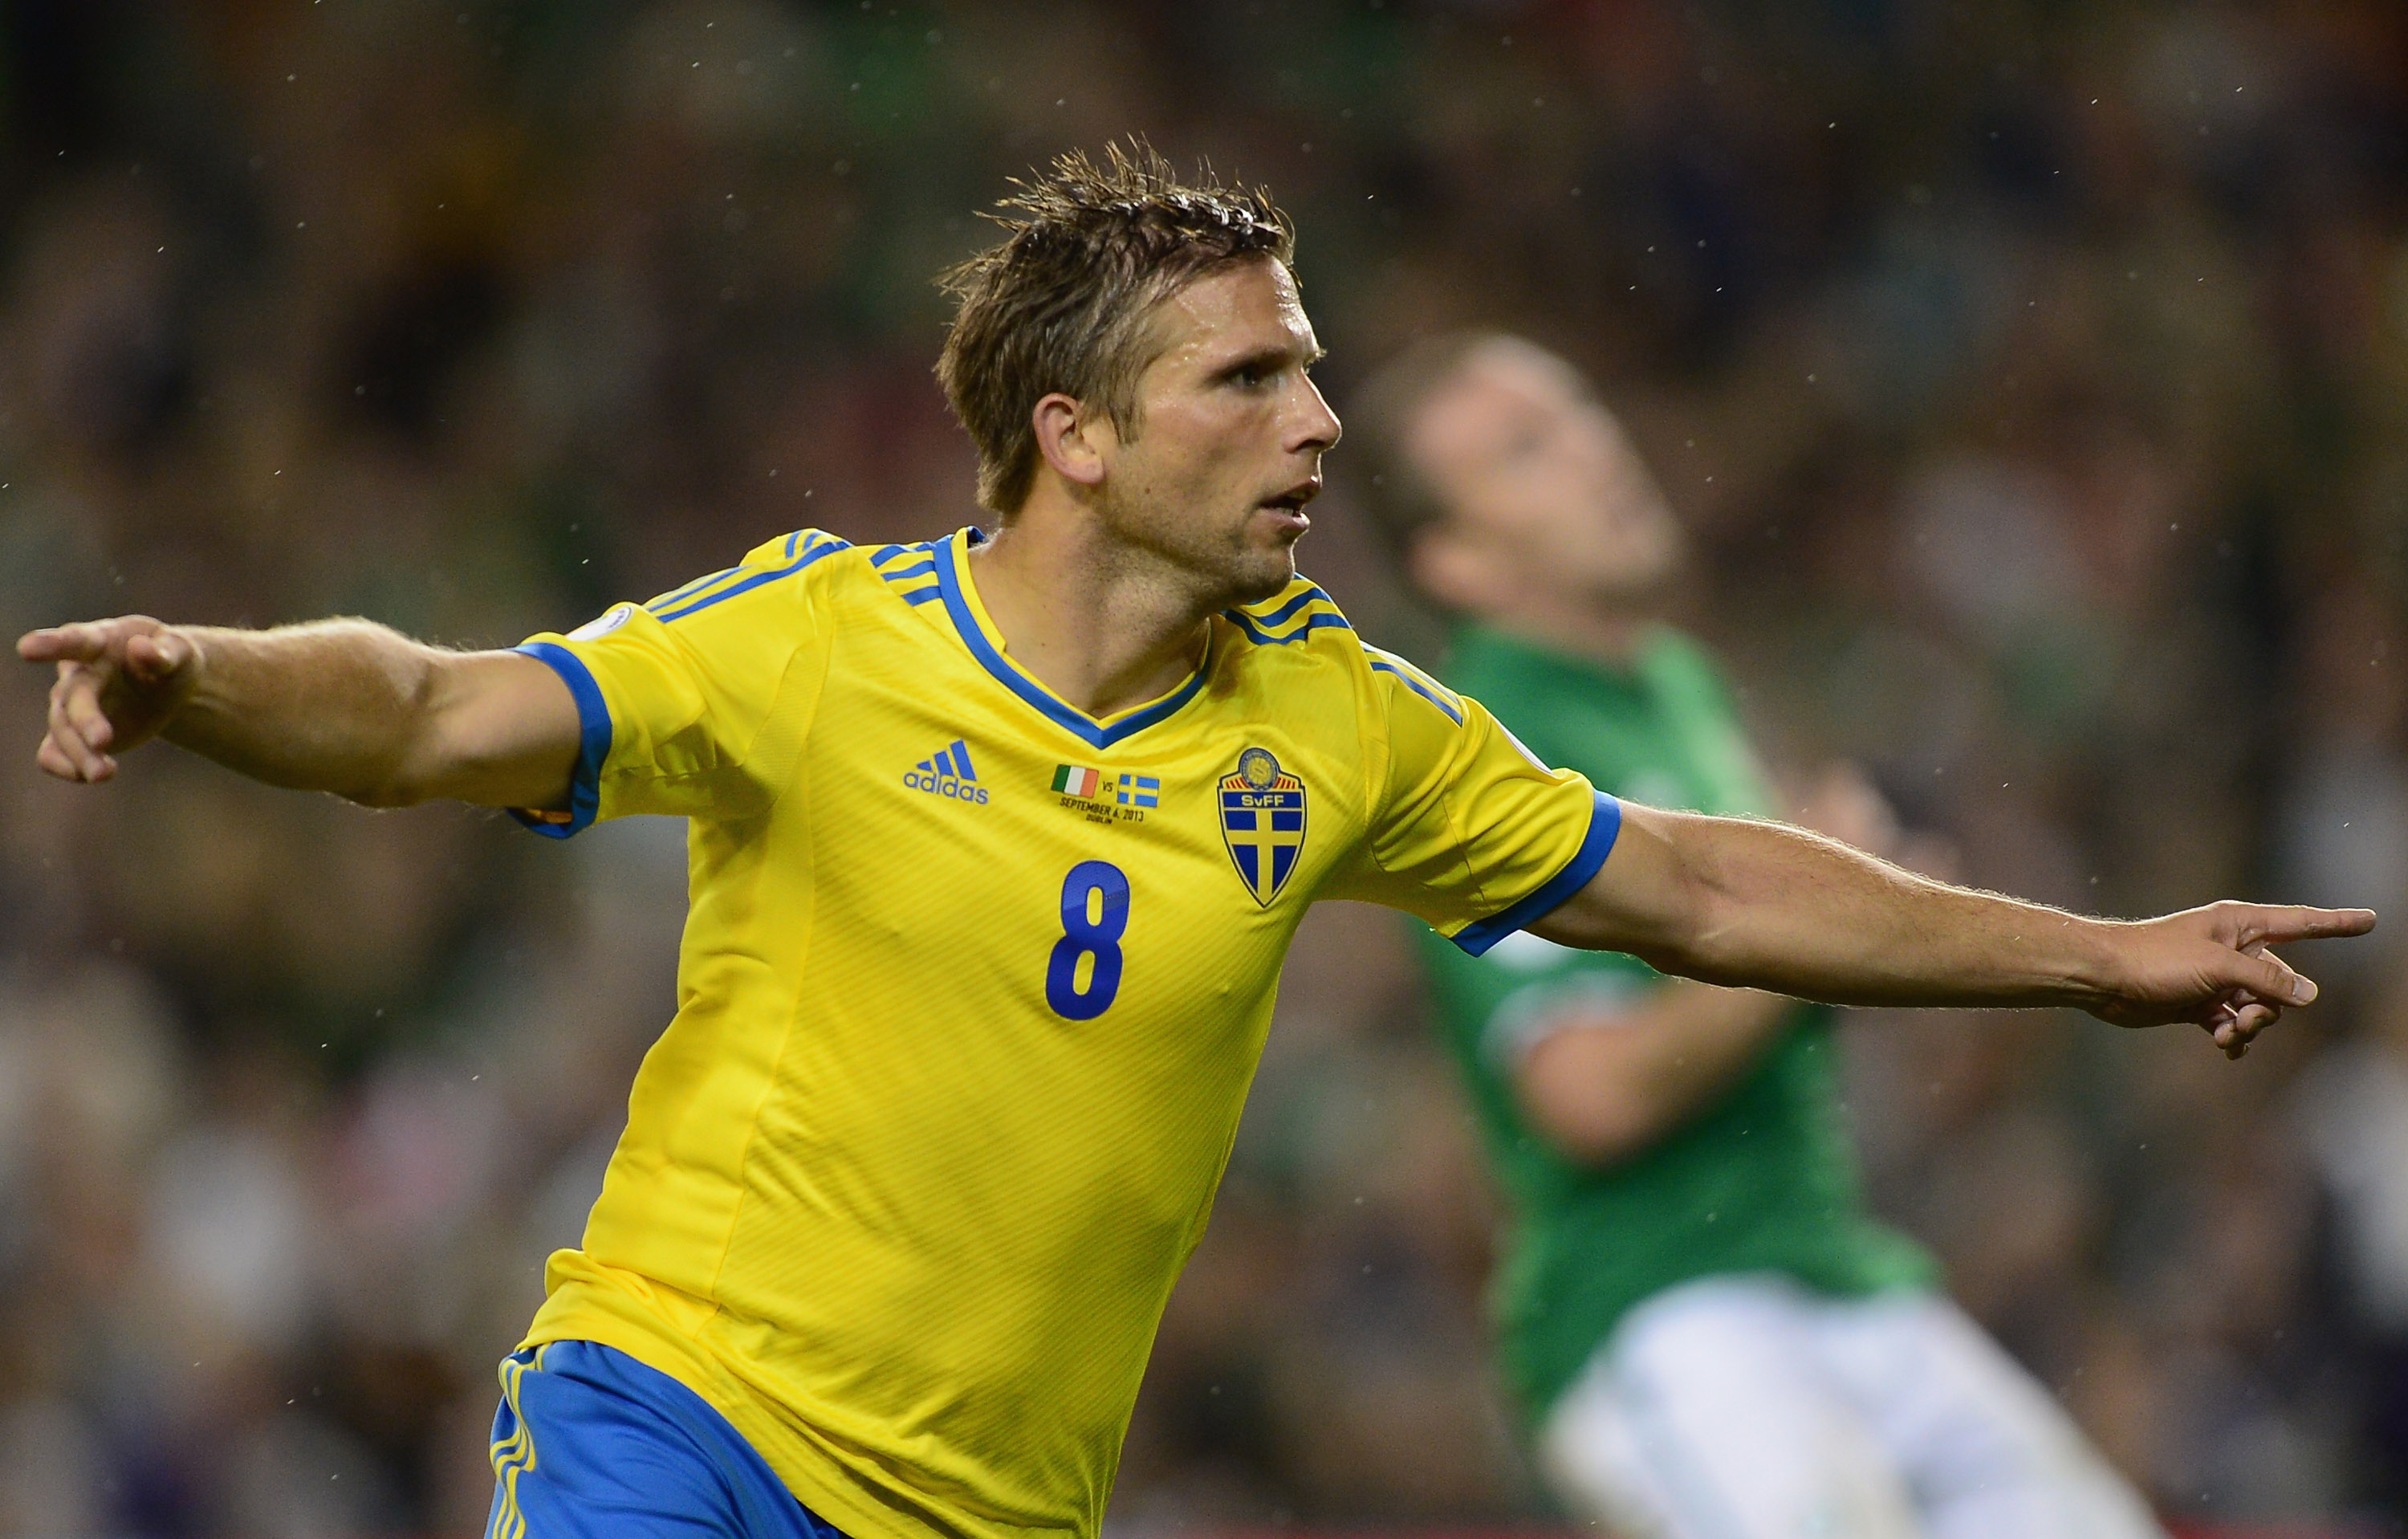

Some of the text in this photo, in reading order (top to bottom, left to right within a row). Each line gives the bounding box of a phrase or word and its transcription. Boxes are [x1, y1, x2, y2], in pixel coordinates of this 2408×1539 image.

[904, 772, 988, 804] adidas
[1060, 798, 1111, 816] SEPTEMBER
[1123, 809, 1145, 822] 2013
[1241, 795, 1284, 807] SvFF
[1086, 814, 1112, 824] DUBLIN
[1045, 860, 1130, 1020] 8
